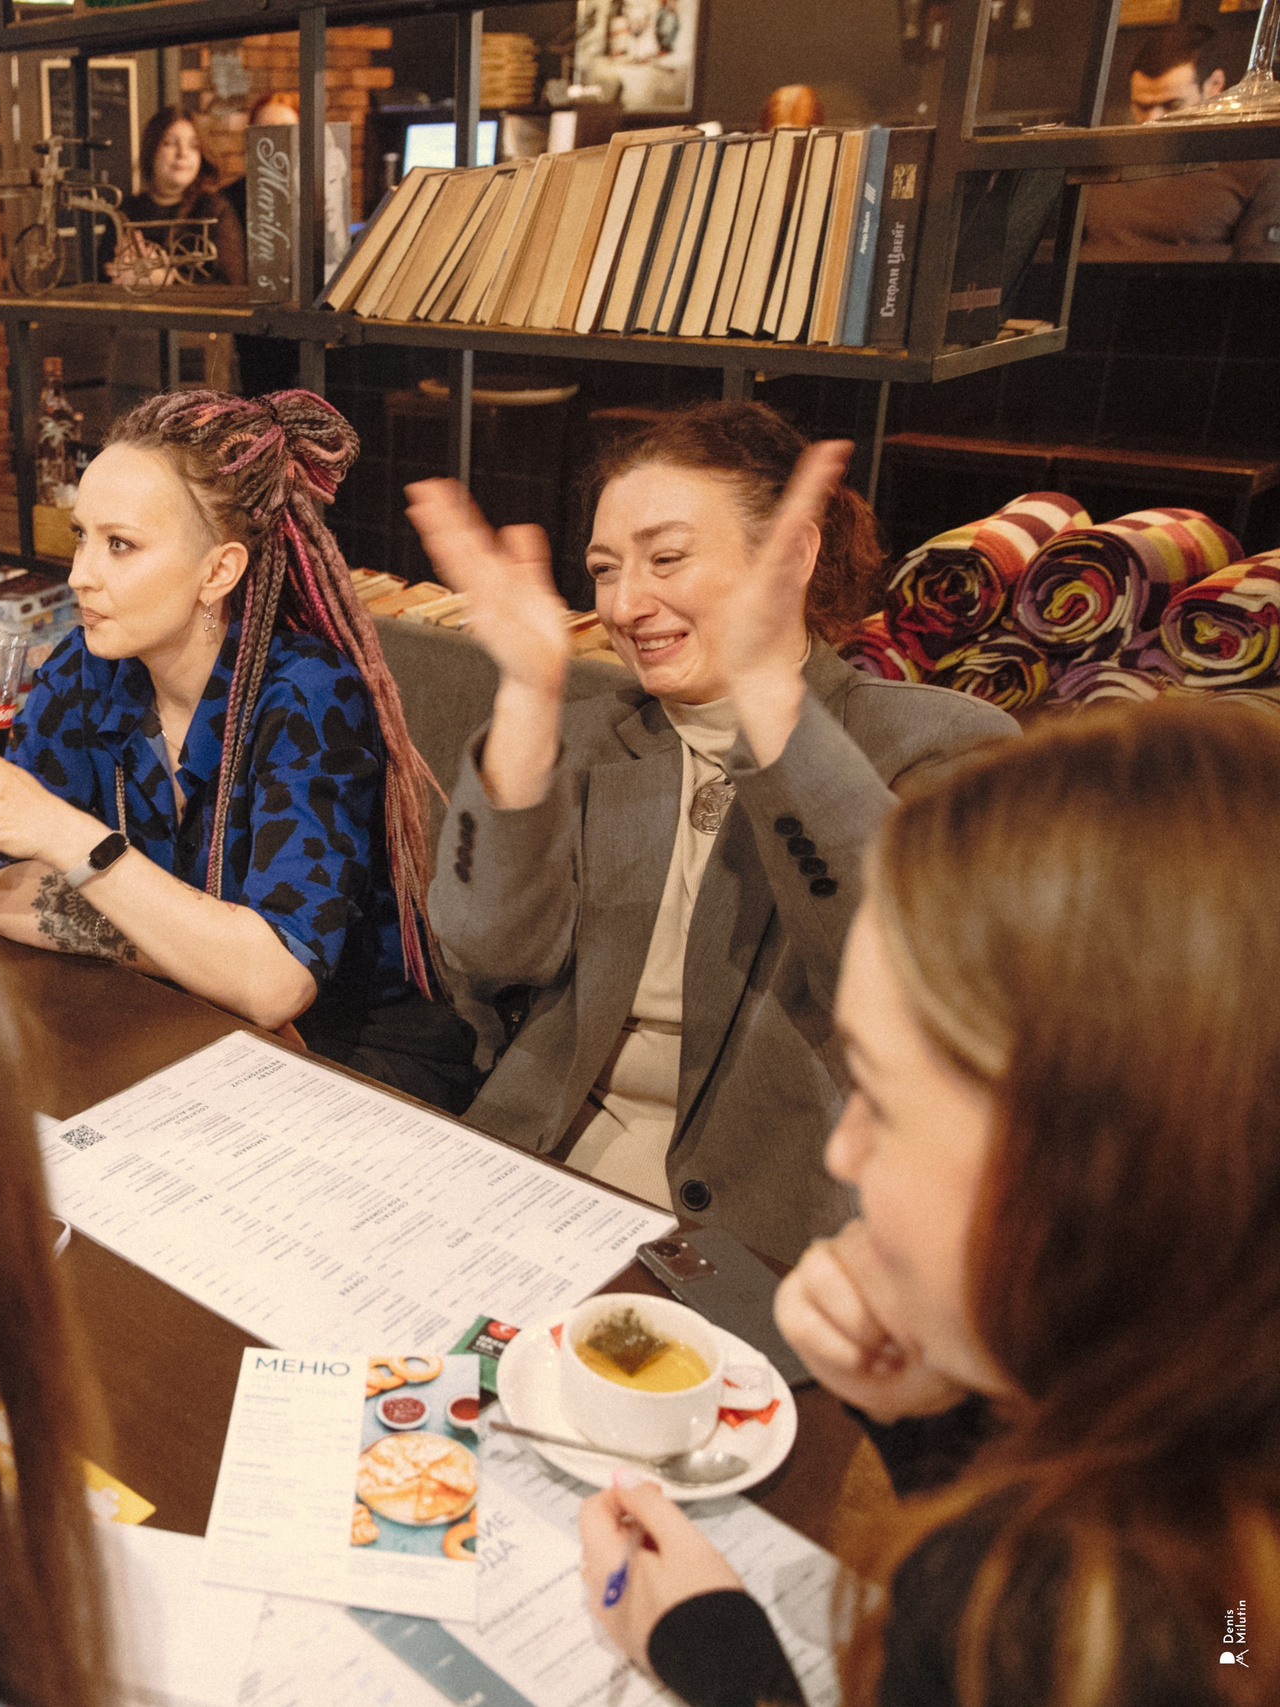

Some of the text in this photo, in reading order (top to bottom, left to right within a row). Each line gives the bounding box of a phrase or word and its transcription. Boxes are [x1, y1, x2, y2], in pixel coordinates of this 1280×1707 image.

[247, 137, 291, 262] Marilyn
[175, 1106, 209, 1124] COCKTAILS
[232, 1135, 270, 1158] LEMONADE
[488, 1165, 519, 1186] COCKTAILS
[374, 1202, 408, 1224] COCKTAILS
[554, 1220, 572, 1234] BEER
[630, 1220, 649, 1236] DRAFT
[448, 1232, 472, 1248] SHOTS
[611, 1237, 628, 1250] BEER
[339, 1276, 368, 1296] COFFEE
[475, 1340, 493, 1351] TEA
[478, 1335, 506, 1350] GREE
[255, 1357, 351, 1377] МЕНЮ
